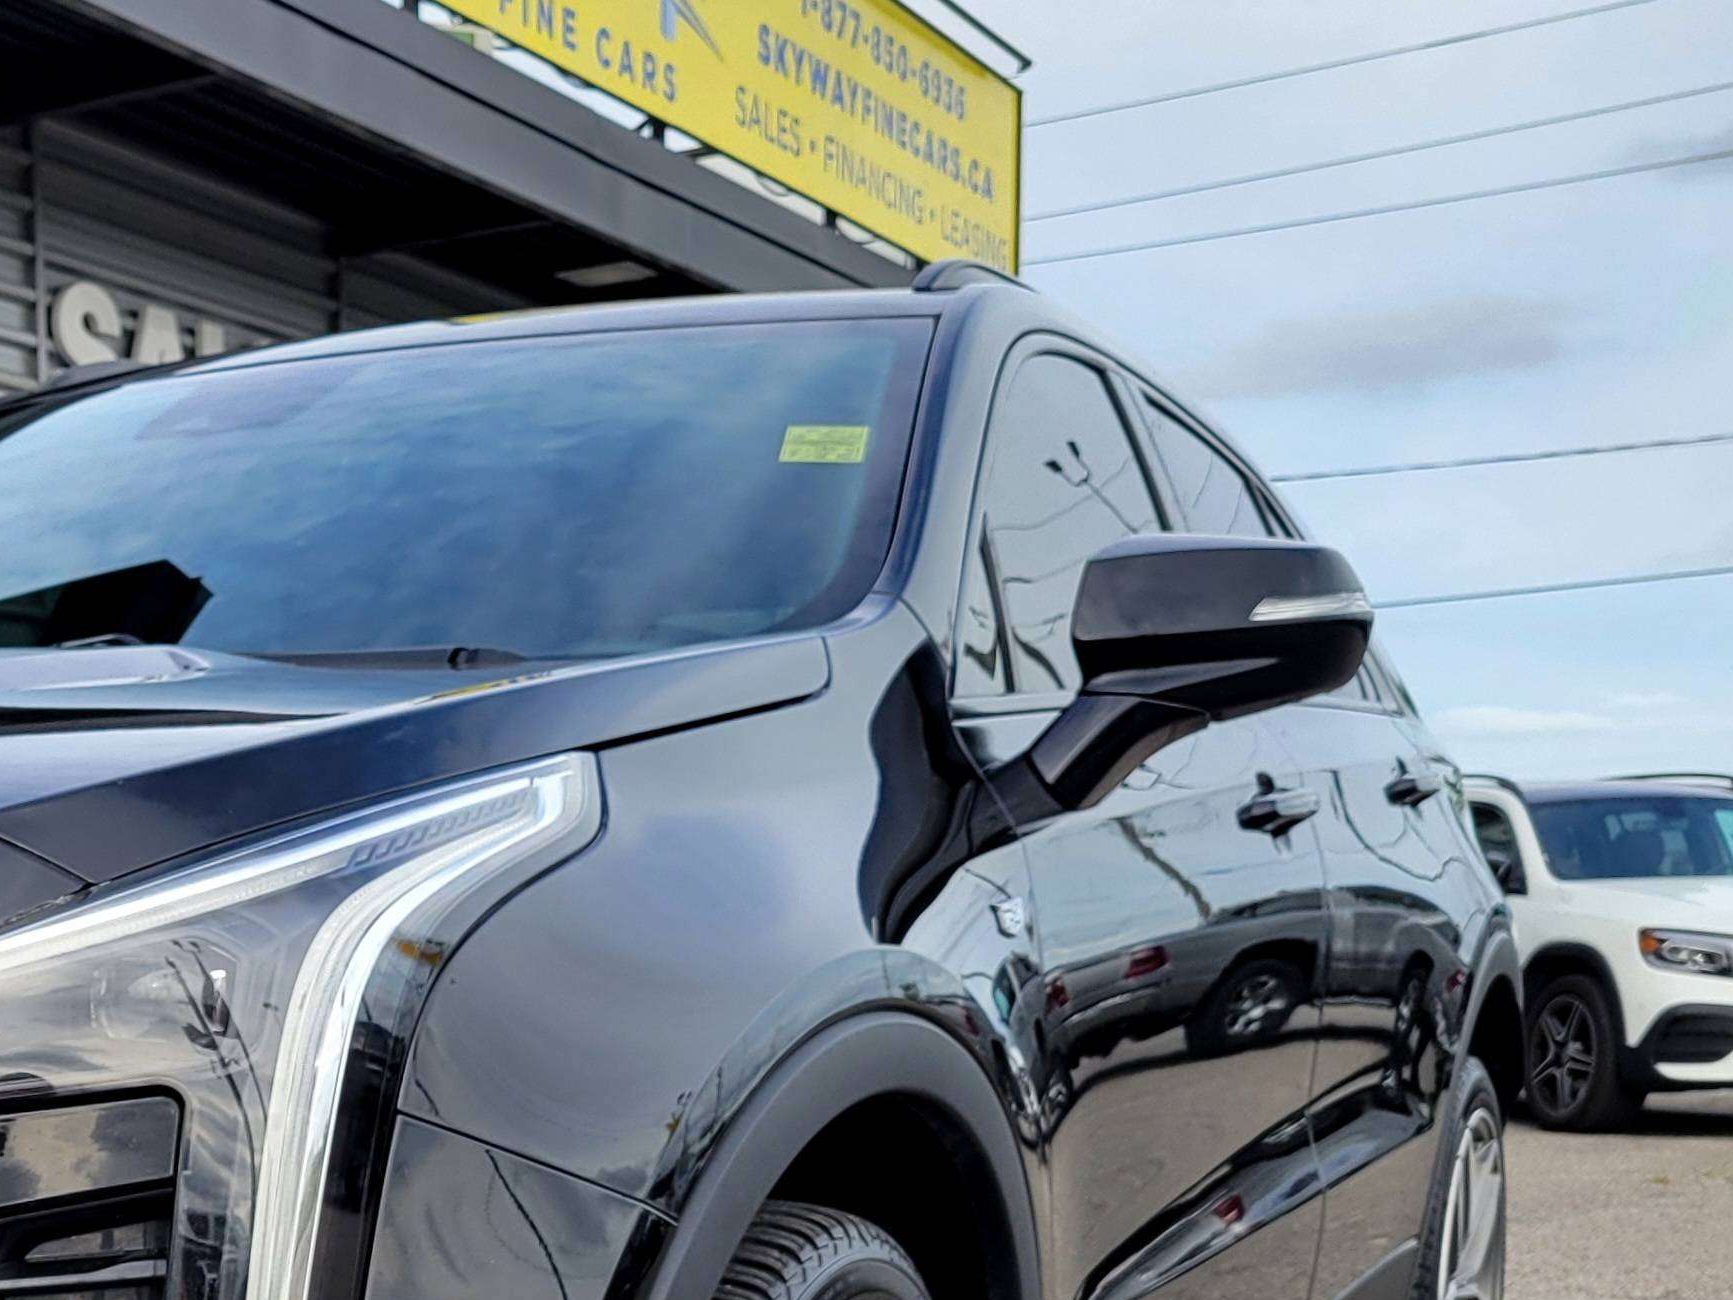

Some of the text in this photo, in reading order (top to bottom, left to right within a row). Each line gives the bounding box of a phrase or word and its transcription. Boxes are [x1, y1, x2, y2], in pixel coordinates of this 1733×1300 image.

[595, 26, 677, 103] CARS
[756, 22, 994, 201] SKYWAYFINECARS.CA
[734, 84, 1009, 273] SALES FINANCING LEASING
